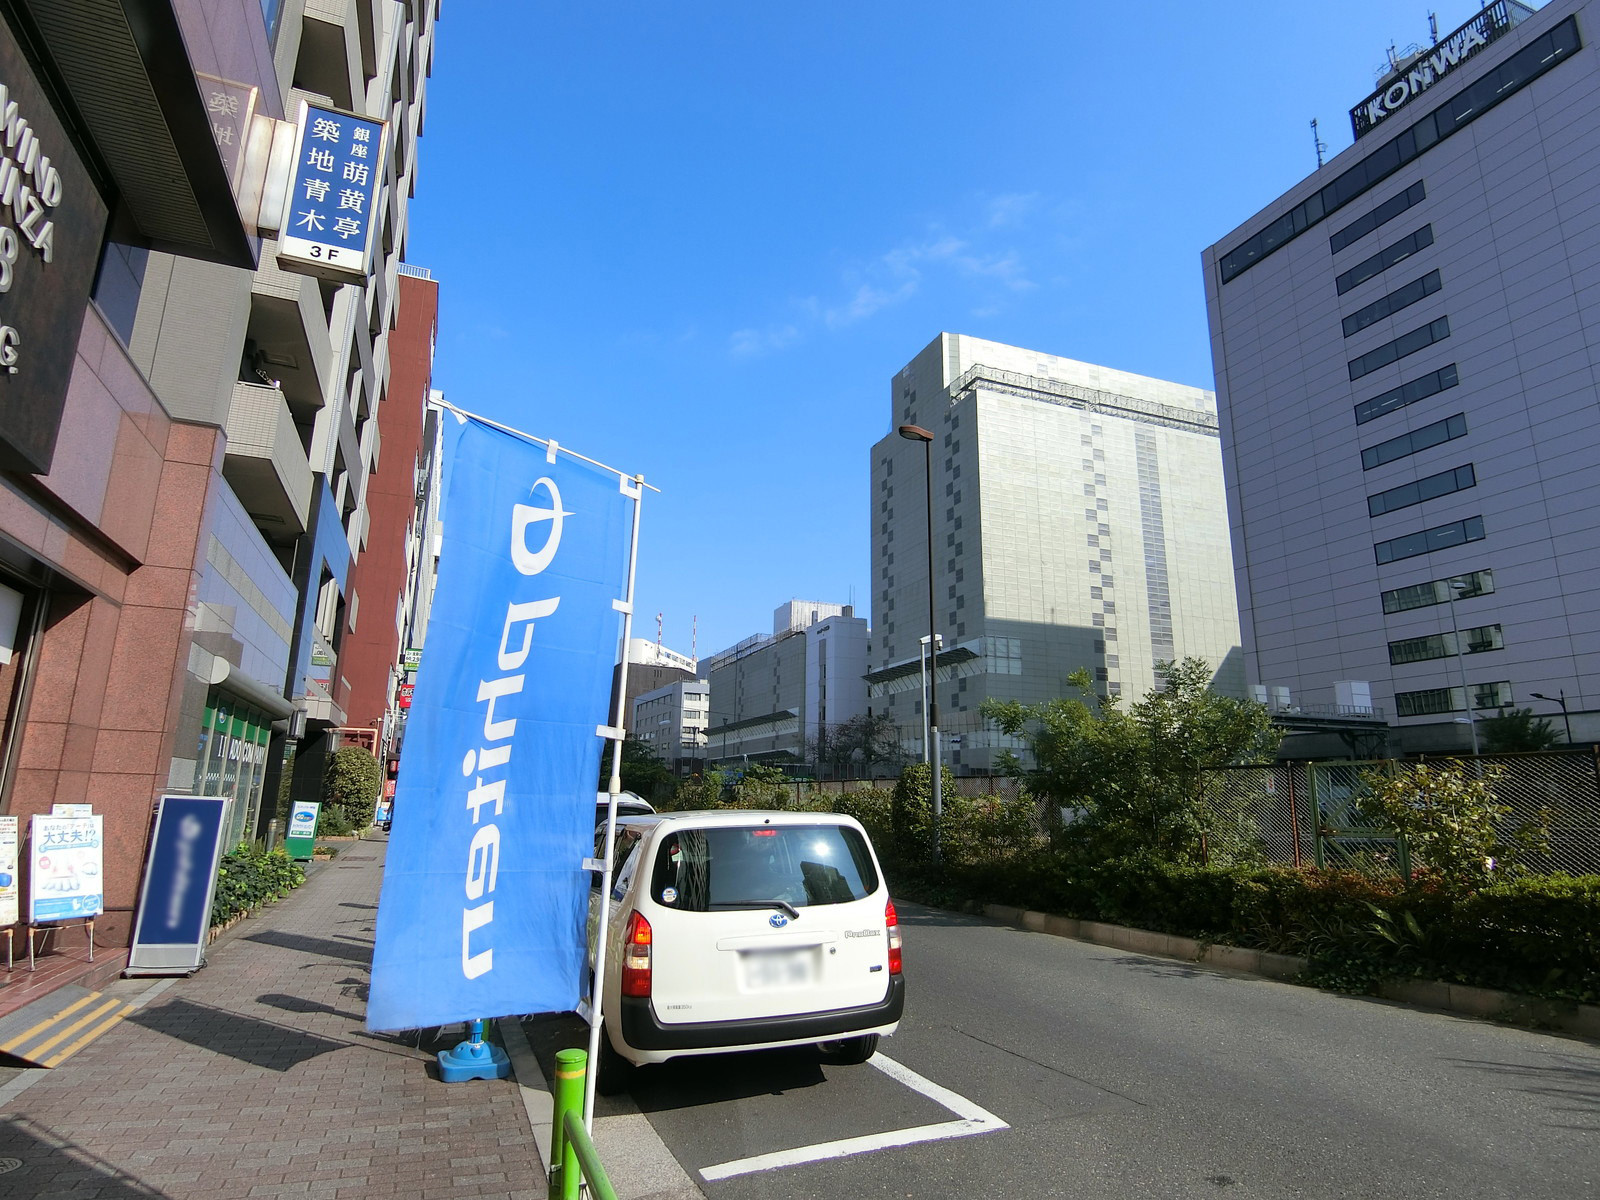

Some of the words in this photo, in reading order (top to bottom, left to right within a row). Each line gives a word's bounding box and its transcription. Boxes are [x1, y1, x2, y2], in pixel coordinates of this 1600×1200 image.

[296, 117, 342, 232] 築地青木
[350, 126, 370, 158] 銀座
[0, 143, 53, 263] INZA
[333, 161, 369, 240] 萌黄亭
[309, 245, 340, 261] 3F
